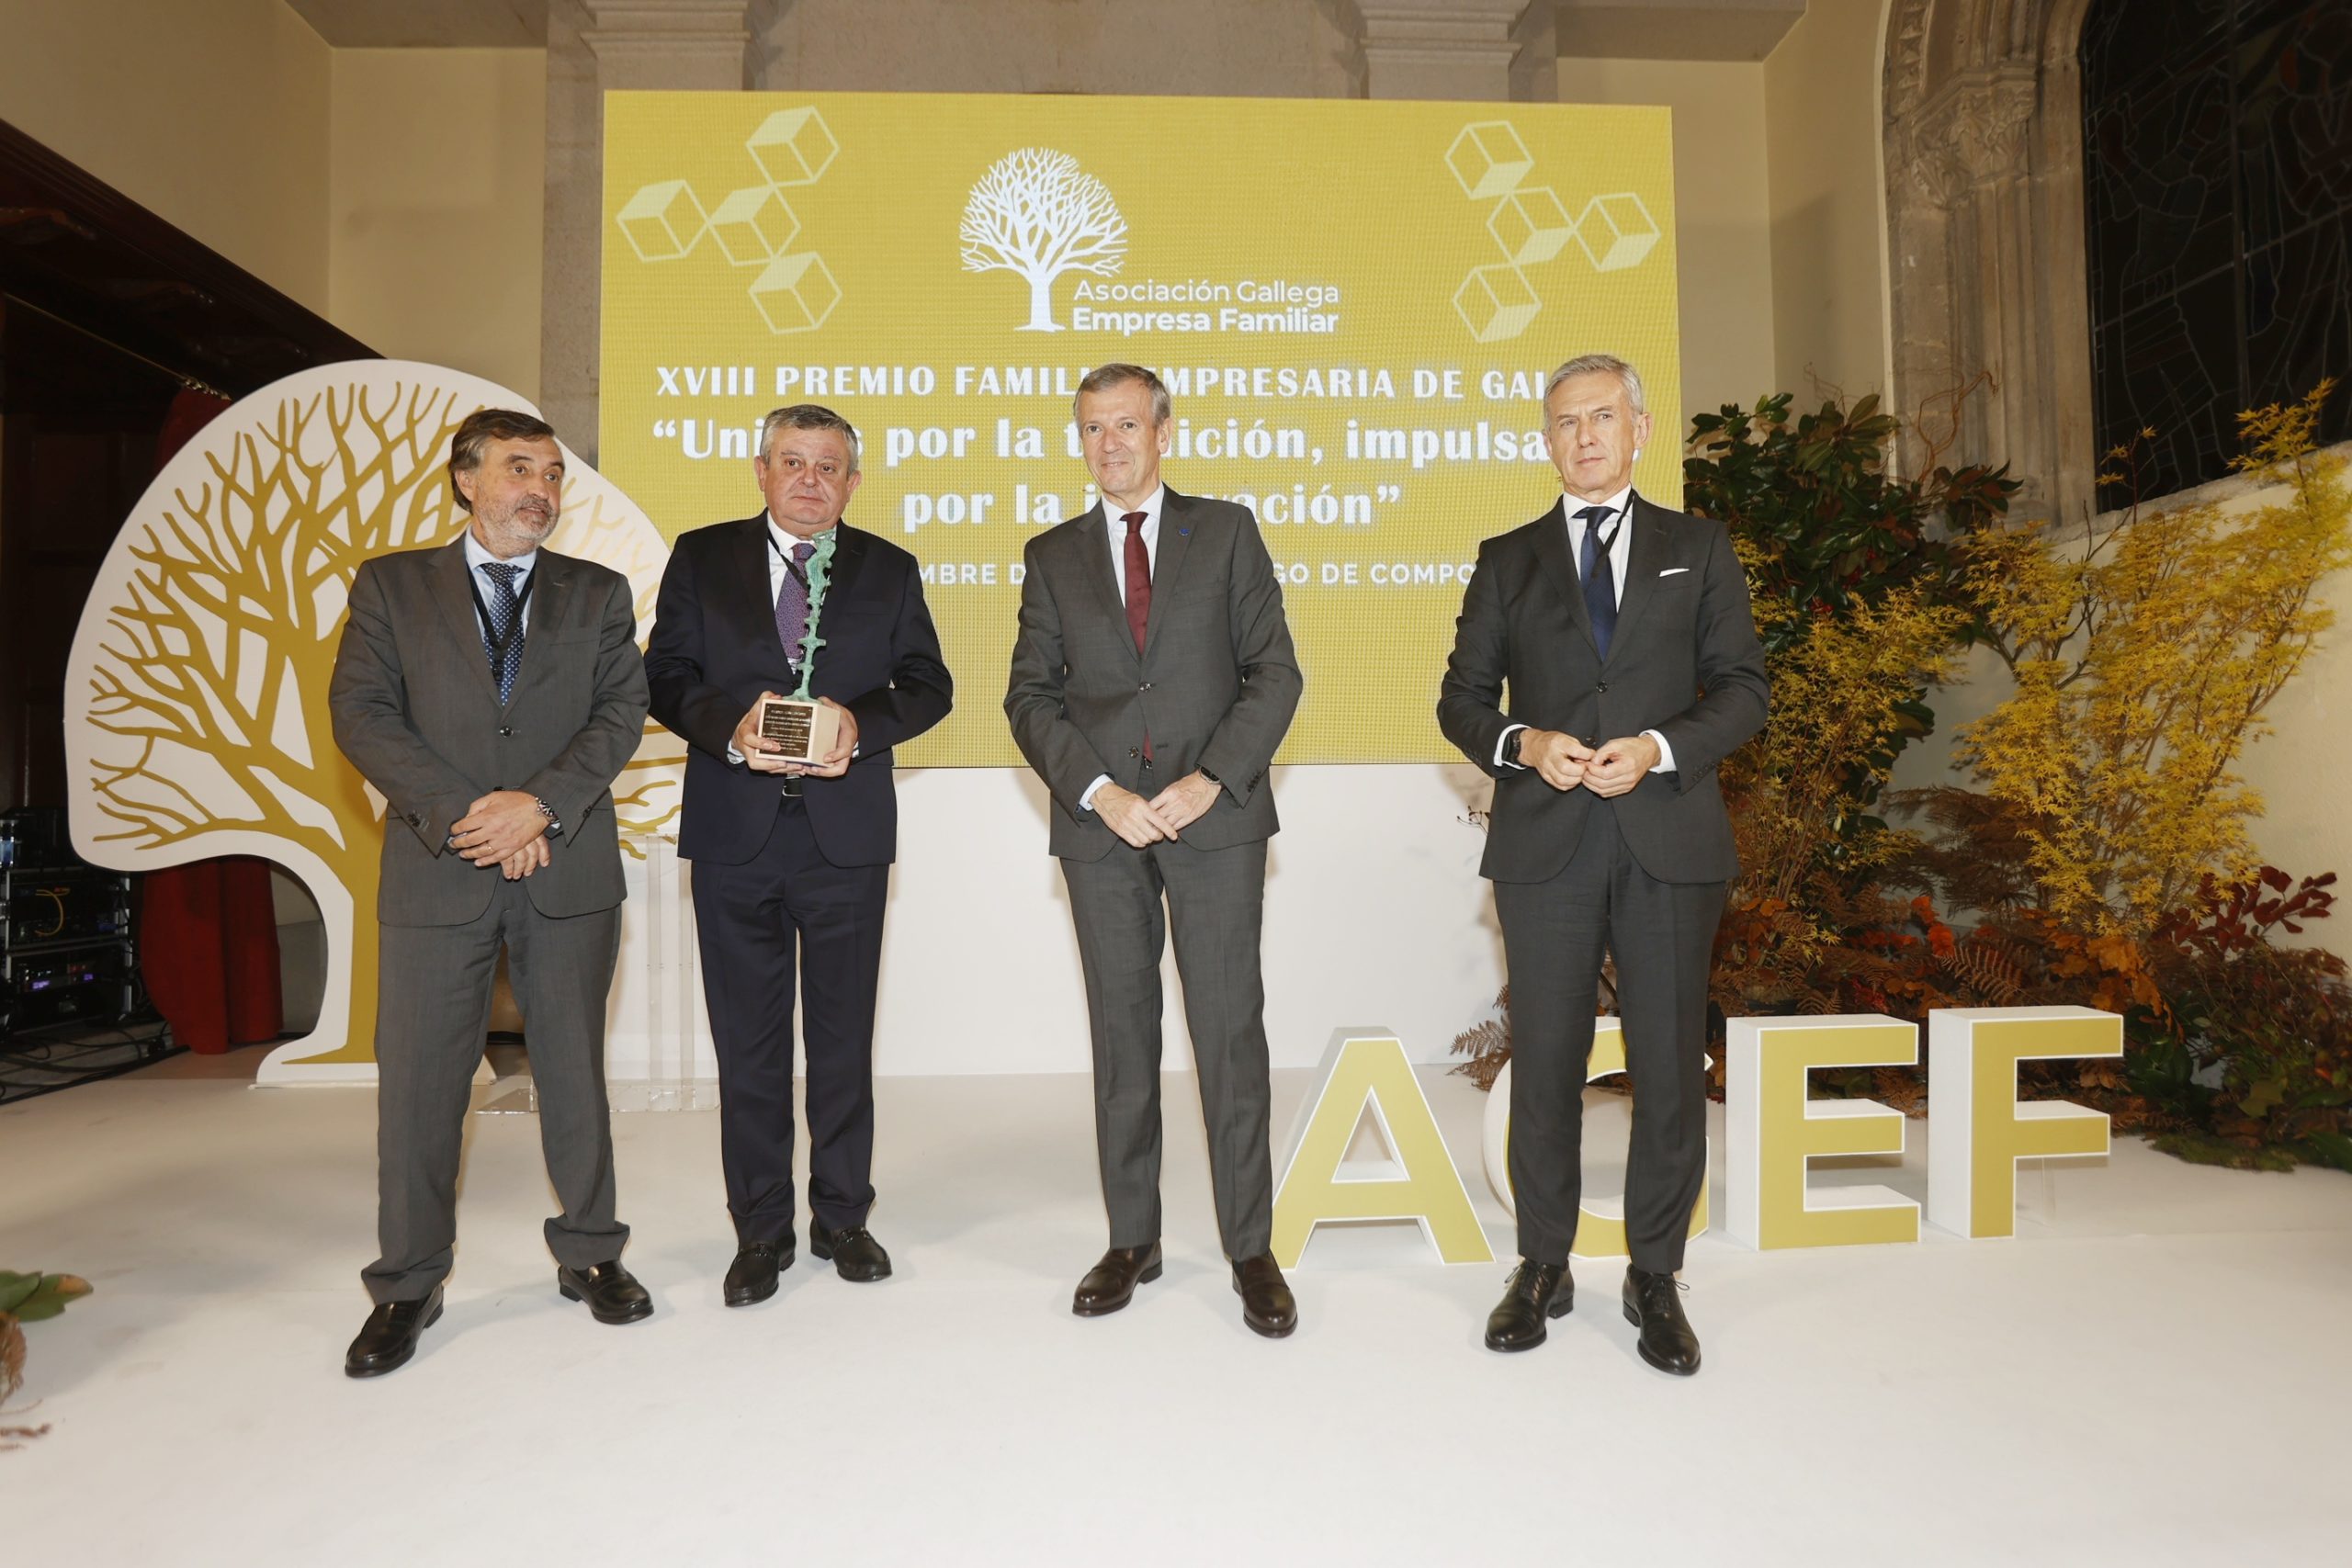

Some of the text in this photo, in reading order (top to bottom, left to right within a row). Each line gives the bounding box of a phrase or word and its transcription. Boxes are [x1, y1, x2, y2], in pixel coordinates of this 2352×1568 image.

[1073, 278, 1339, 309] Asociación Gallega
[1072, 306, 1339, 337] Empresa Familiar
[657, 367, 754, 395] XVIII
[775, 367, 935, 396] PREMIO
[956, 367, 1090, 396] FAMIL
[1413, 369, 1464, 400] DE
[1481, 369, 1545, 400] GAL
[886, 427, 976, 467] por
[996, 418, 1045, 458] la
[1064, 418, 1323, 466] tición,
[1347, 419, 1551, 469] impulsa
[903, 493, 994, 534] por
[1015, 484, 1064, 525] la
[920, 563, 1476, 585] MBRE D GO DE COMPO
